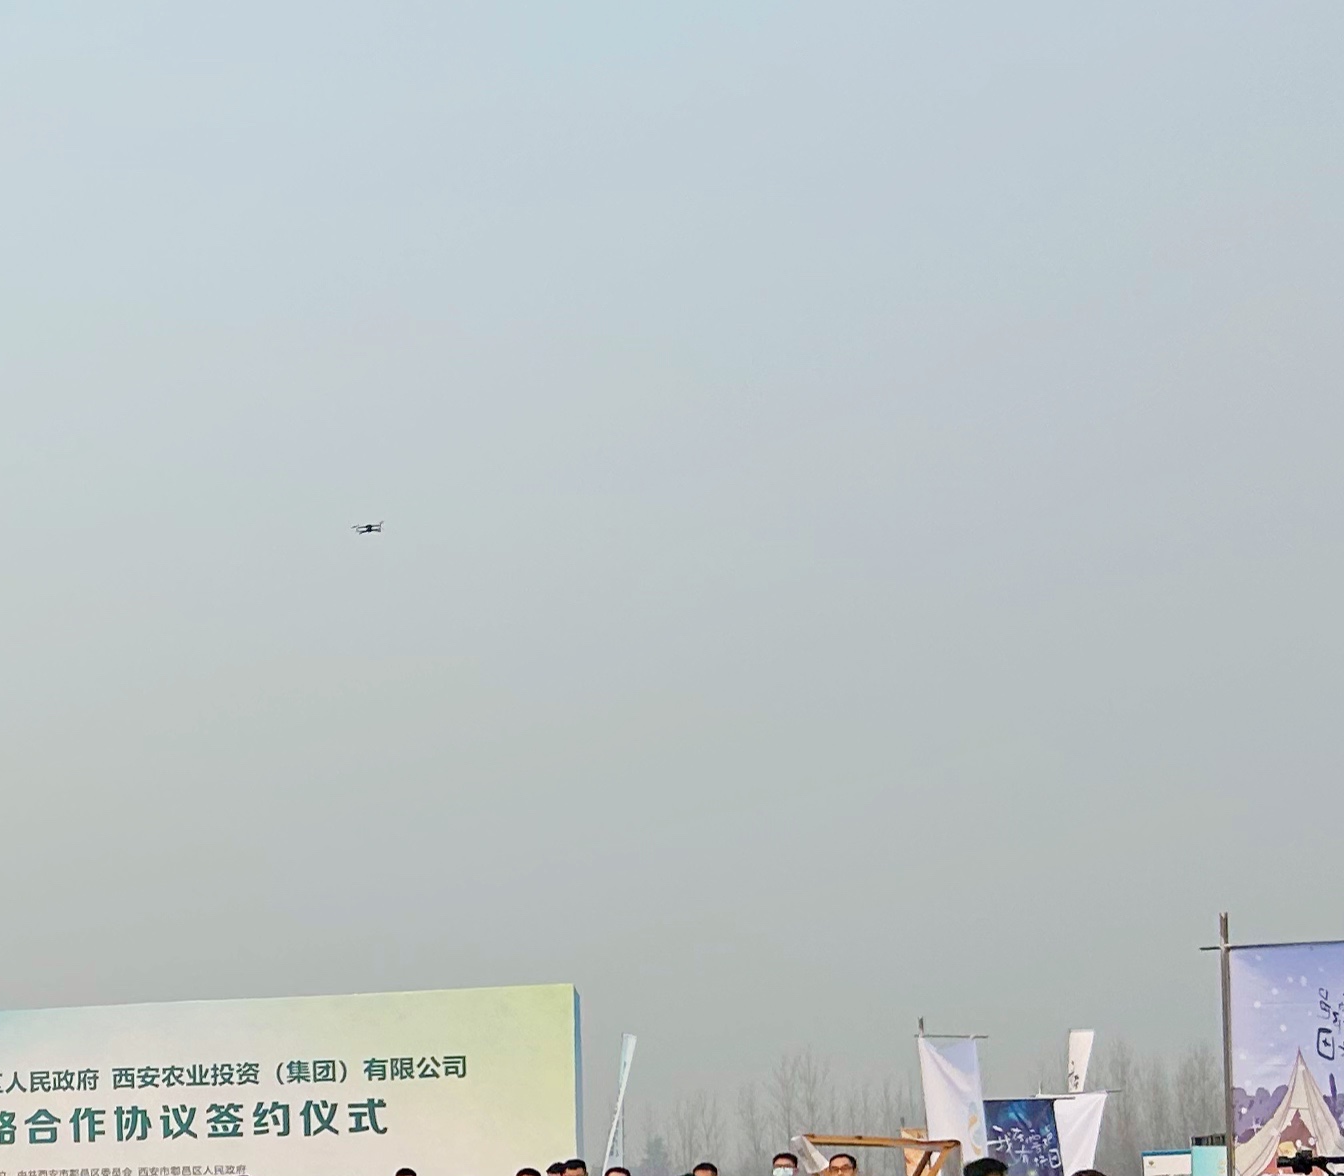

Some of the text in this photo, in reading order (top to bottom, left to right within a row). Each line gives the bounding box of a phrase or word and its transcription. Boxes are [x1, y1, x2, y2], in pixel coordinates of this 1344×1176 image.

[111, 1055, 467, 1090] 西安农业投资（集团）有限公司
